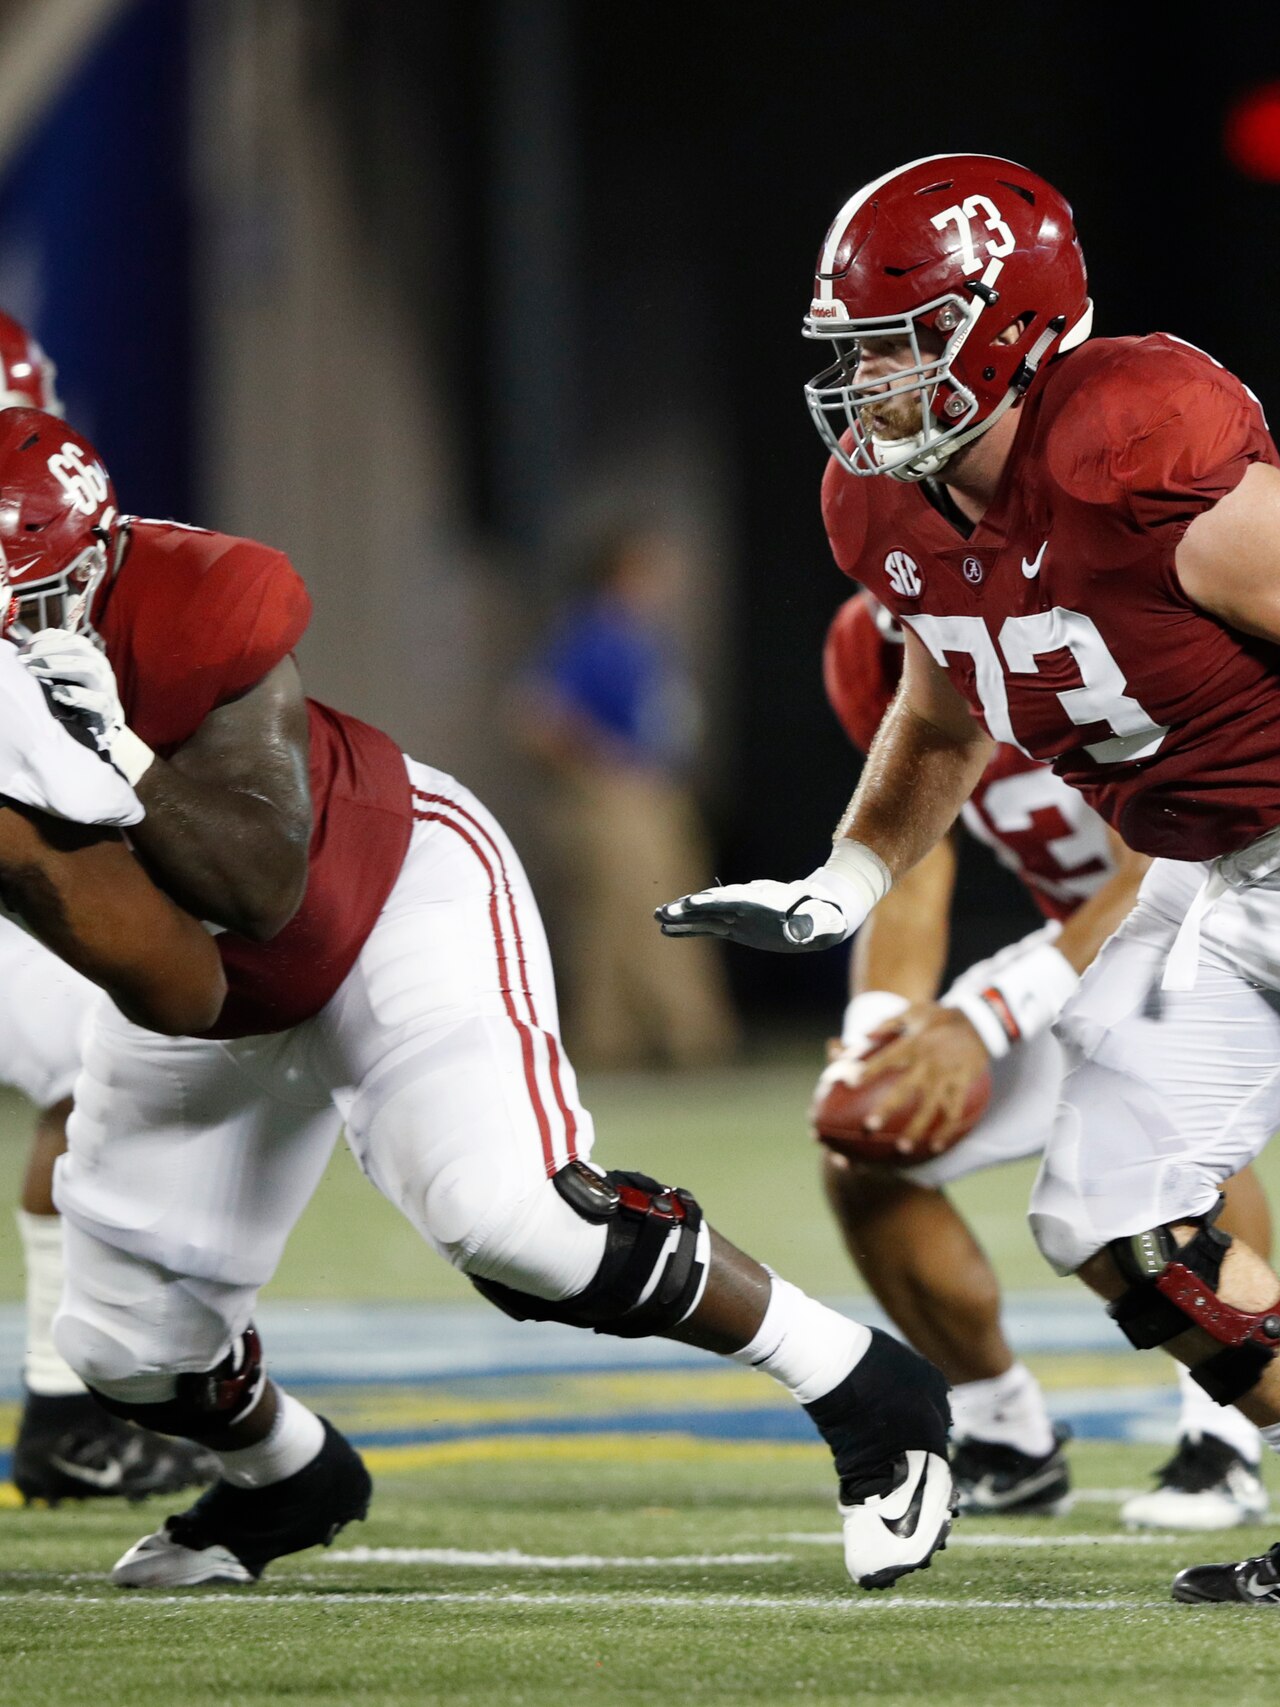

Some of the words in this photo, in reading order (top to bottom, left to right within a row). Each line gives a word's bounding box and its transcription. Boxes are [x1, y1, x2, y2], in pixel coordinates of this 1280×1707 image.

[930, 194, 1016, 276] 73
[47, 441, 108, 516] 66
[884, 550, 922, 597] SEC
[900, 606, 1170, 765] 73
